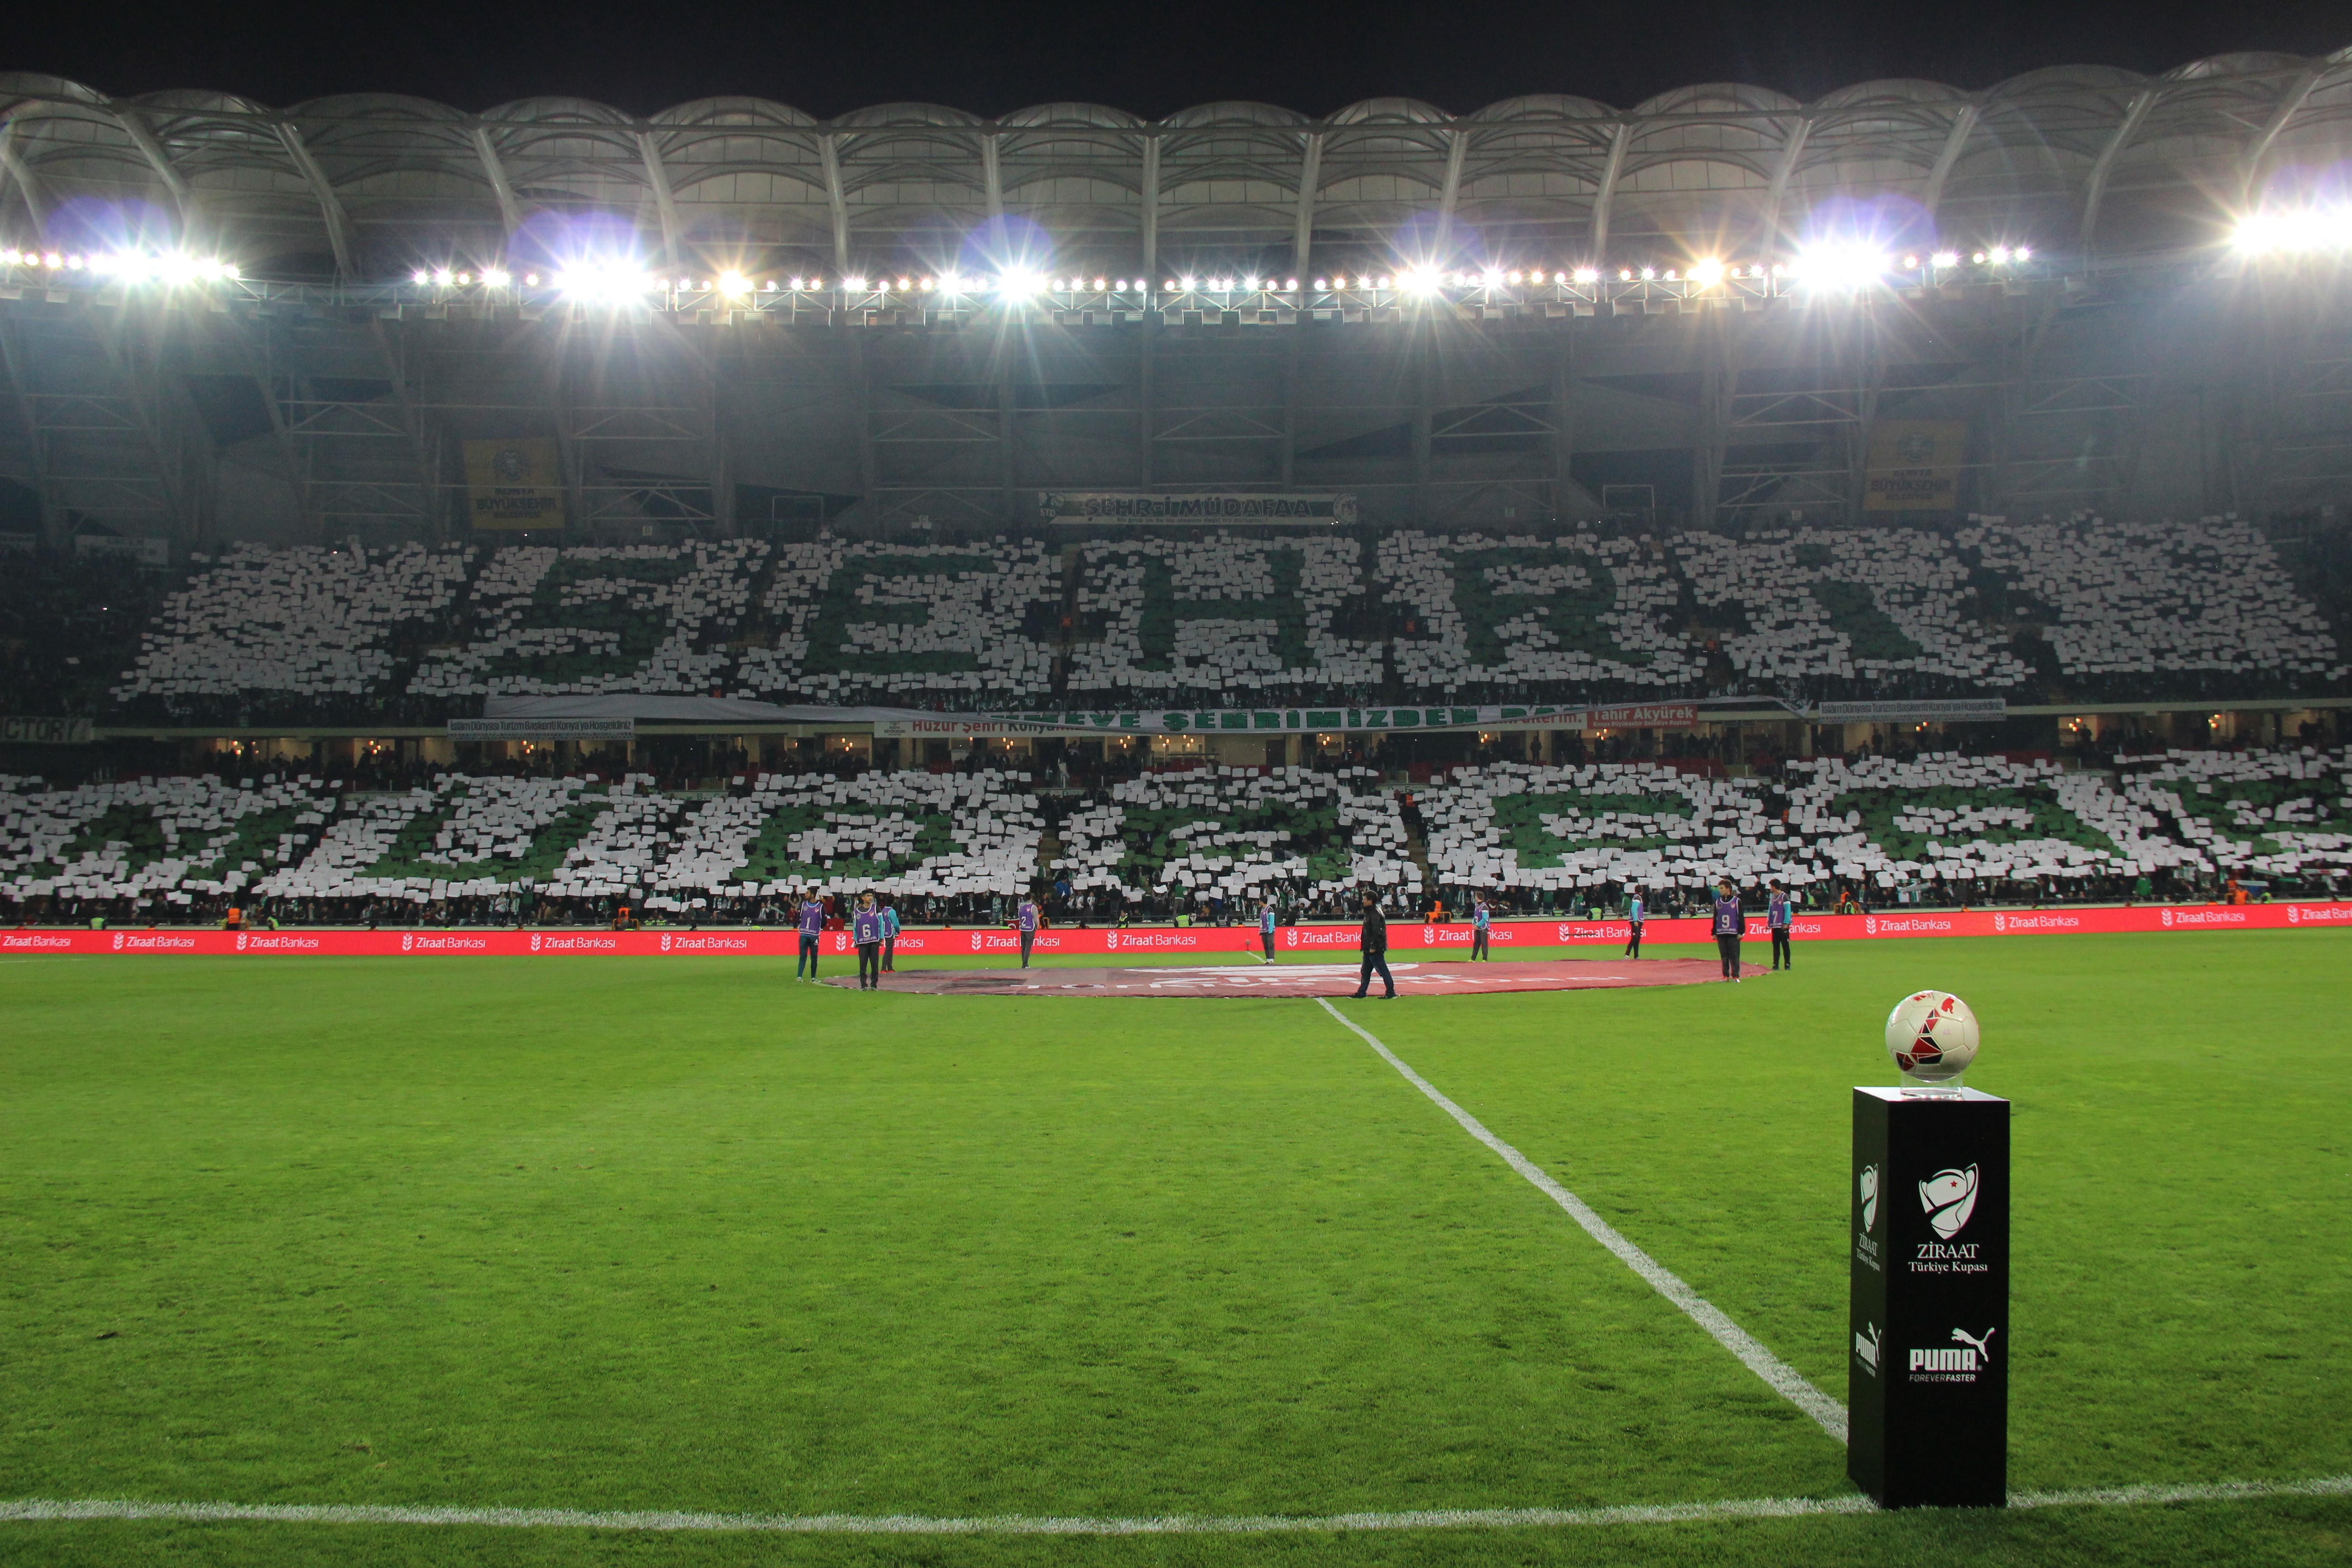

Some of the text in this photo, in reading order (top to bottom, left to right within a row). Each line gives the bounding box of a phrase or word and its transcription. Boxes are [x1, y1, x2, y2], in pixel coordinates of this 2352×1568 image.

[1178, 496, 1312, 517] MÜDAFAA
[1635, 706, 1694, 722] Akyürek
[500, 720, 524, 730] Turizm
[1773, 911, 1778, 923] 7
[2176, 911, 2245, 923] Ziraat Bankası
[2301, 909, 2331, 920] Ziraat
[805, 917, 811, 929] 1
[1021, 916, 1026, 926] 2
[1721, 914, 1730, 928] 9
[1881, 919, 1951, 931] Ziraat Bankası
[2009, 916, 2078, 928] Ziraat Bankası
[862, 924, 871, 938] 6
[1574, 926, 1646, 938] Ziraat Banksı
[1789, 923, 1821, 933] ankası
[3, 936, 71, 946] Ziraat Bankası
[127, 936, 195, 947] Ziraat Bankası
[986, 936, 1017, 947] Ziraat
[1122, 934, 1196, 946] Ziraat Bankası
[1302, 932, 1334, 943] Ziraat
[1439, 930, 1470, 941] Ziraat
[250, 936, 319, 948] Ziraat Bankası
[416, 937, 485, 948] Ziraat Bankası
[545, 937, 616, 948] Ziraat Bankası
[675, 937, 747, 948] Ziraat Bankası
[1859, 1232, 1878, 1256] ZİRAAT
[1917, 1241, 1980, 1259] ZİRAAT
[1908, 1261, 1988, 1274] Türkiye Kupası
[1856, 1331, 1876, 1367] PUMA
[1910, 1349, 1976, 1371] PUMA
